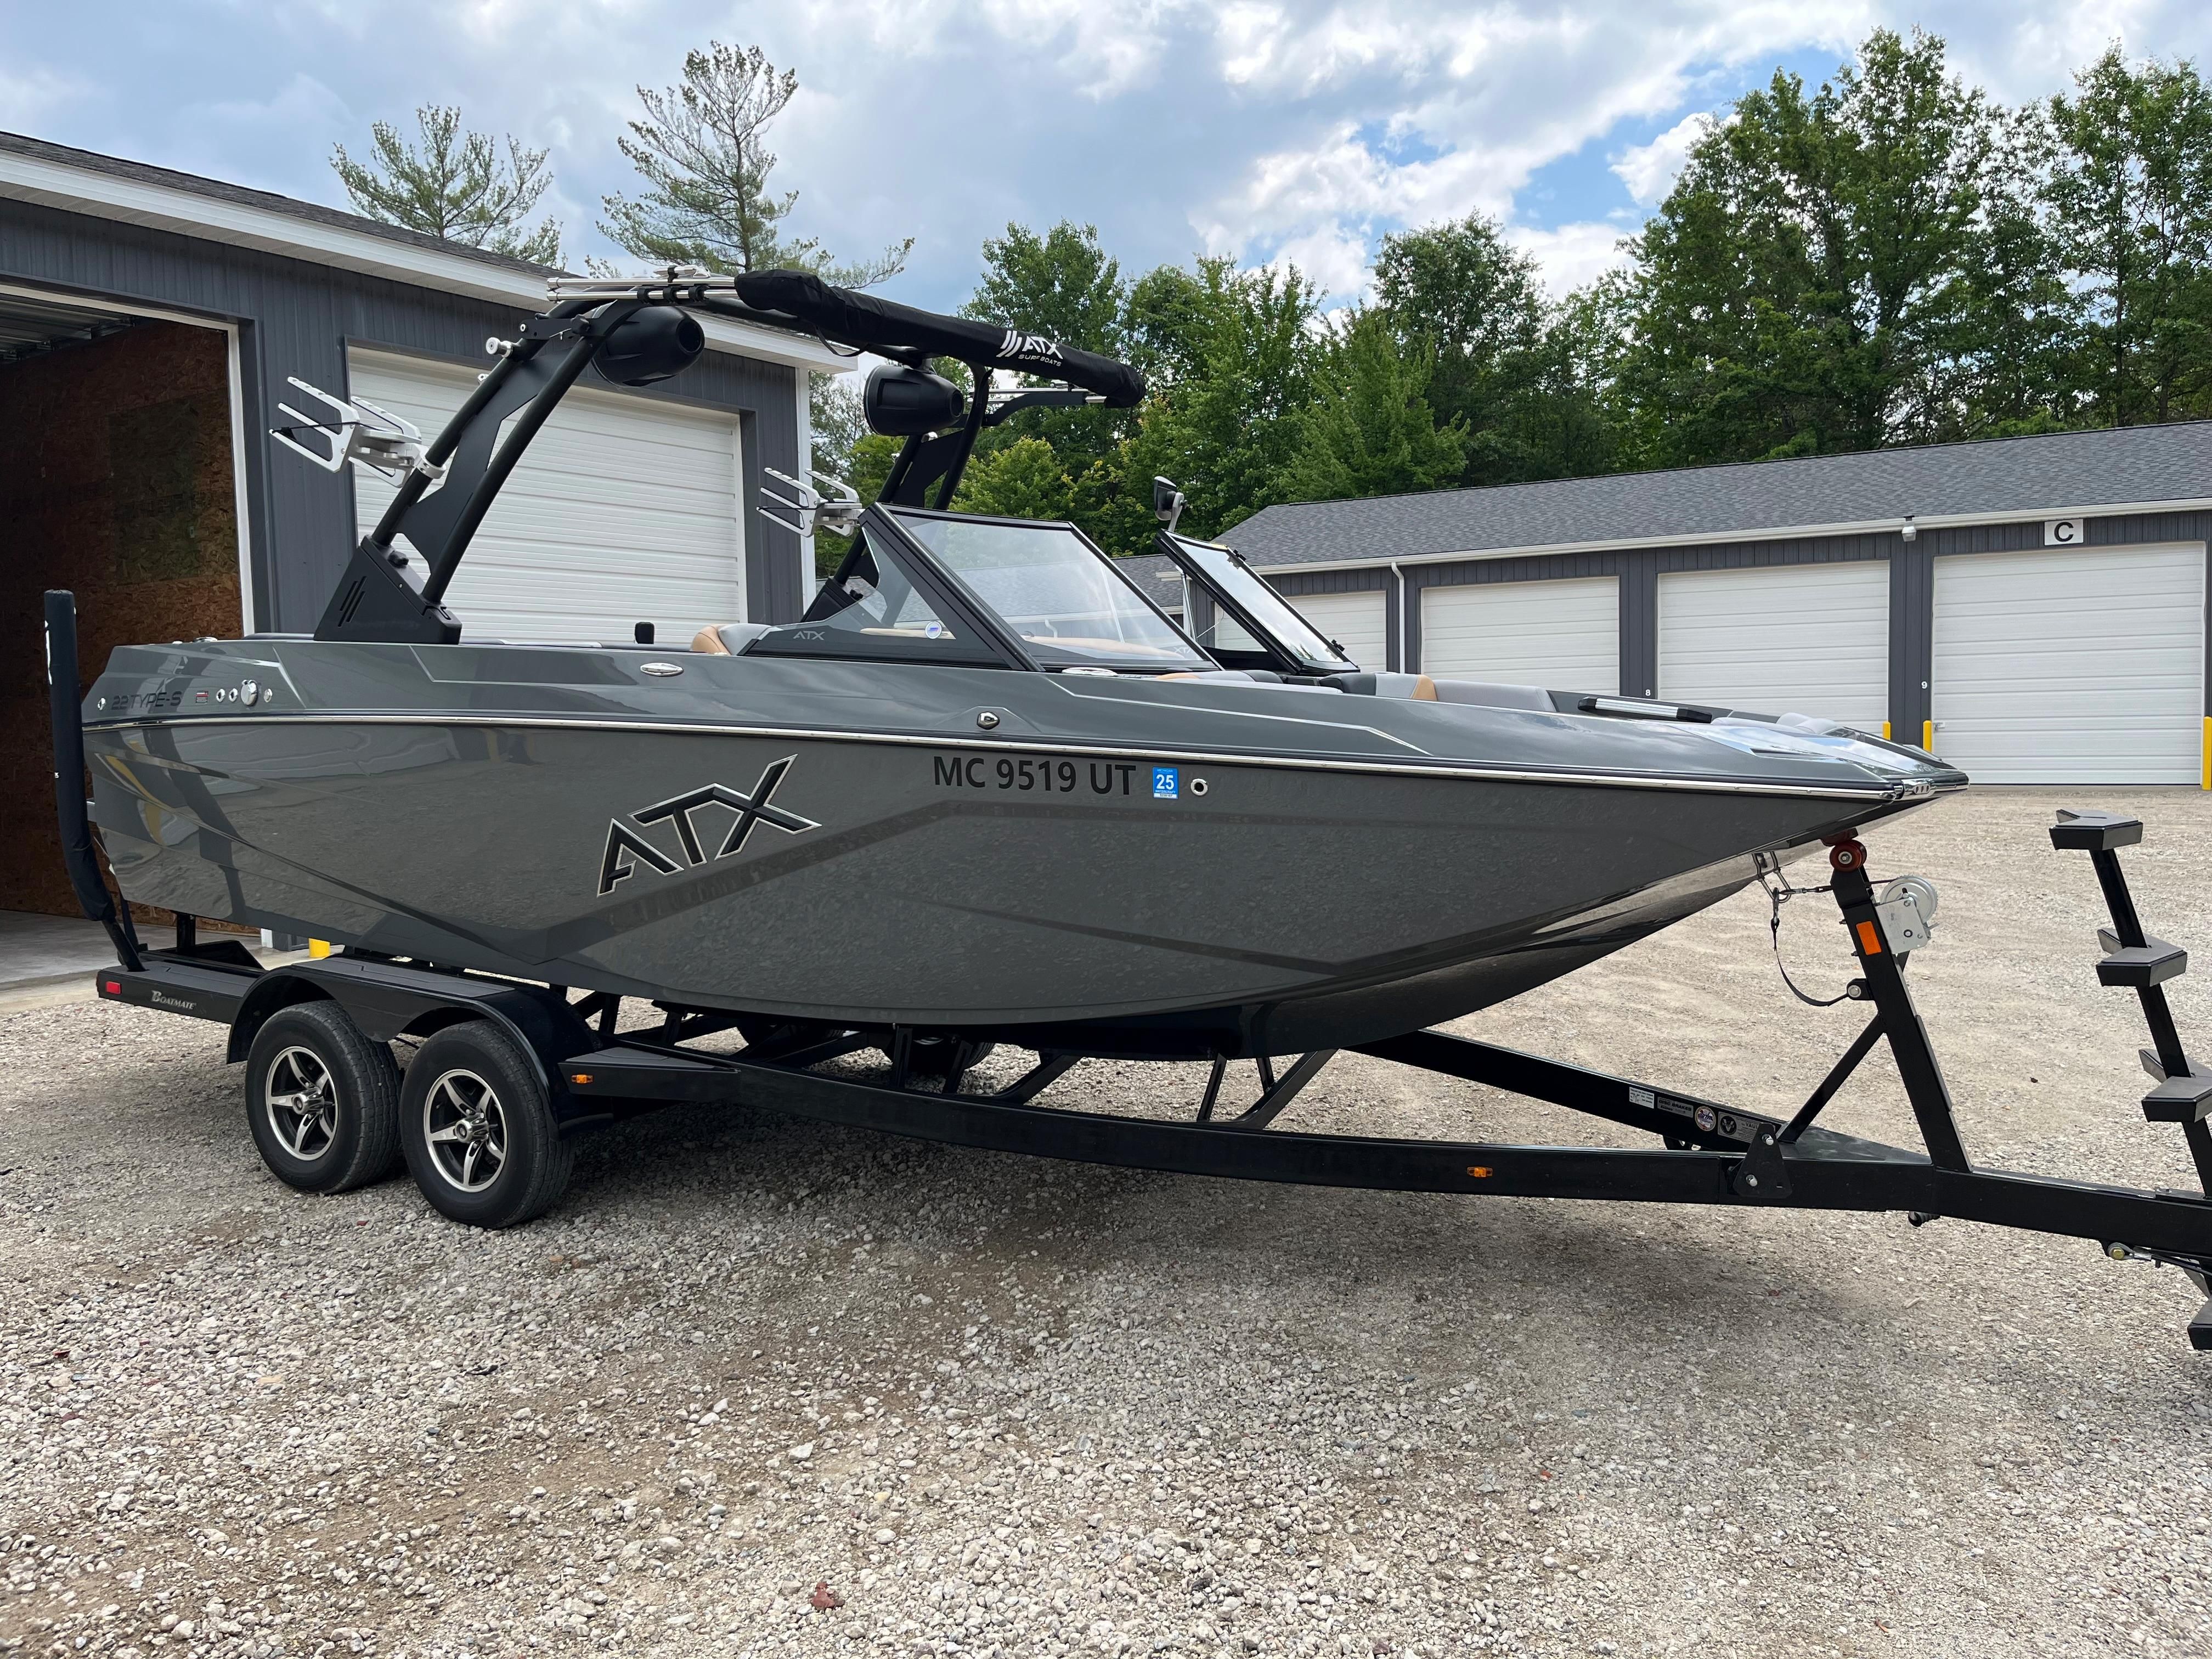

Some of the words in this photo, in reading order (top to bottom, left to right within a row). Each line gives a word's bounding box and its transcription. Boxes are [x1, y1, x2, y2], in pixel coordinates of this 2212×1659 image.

[1022, 336, 1063, 359] ATX
[1040, 356, 1062, 366] BOATS
[2054, 521, 2074, 542] C
[793, 630, 826, 641] ATX
[1921, 681, 1927, 689] 9
[111, 695, 128, 710] 22
[130, 691, 182, 708] TYPE-S
[934, 756, 986, 788] MC
[996, 759, 1076, 793] 9519
[1091, 763, 1136, 795] UT
[1156, 774, 1175, 790] 25
[596, 753, 823, 898] ATX
